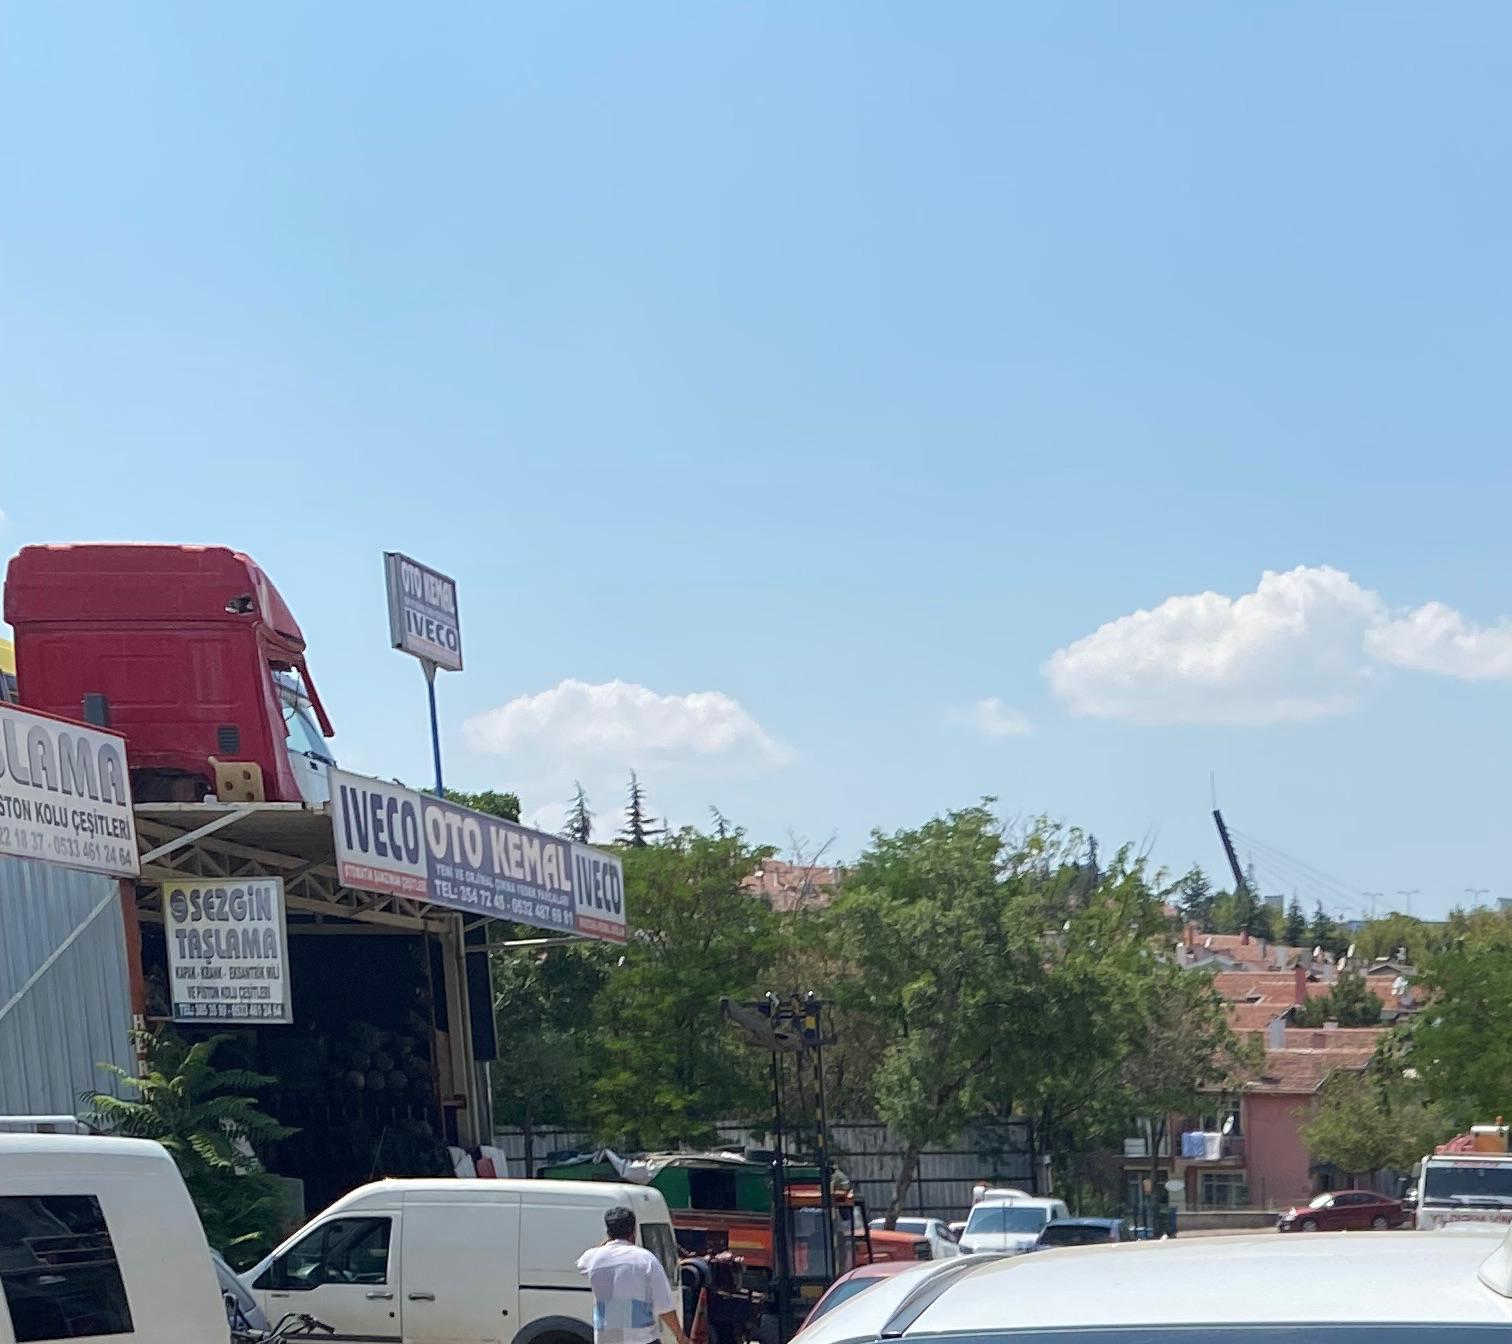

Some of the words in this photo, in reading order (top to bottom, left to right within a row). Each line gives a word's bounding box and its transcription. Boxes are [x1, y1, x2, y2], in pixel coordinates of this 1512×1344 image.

[401, 560, 422, 599] OTO
[405, 610, 458, 652] IVECO
[0, 718, 127, 808] LAMA
[34, 800, 69, 828] KOLU
[71, 808, 131, 840] ÇEŞİTLERİ
[340, 785, 420, 865] IVECO
[425, 806, 483, 869] OTO
[490, 825, 572, 892] KEMAL
[190, 885, 272, 922] SEZGİN
[434, 879, 458, 899] TEL:
[575, 854, 622, 915] IVECO
[175, 928, 277, 965] TAŞLAMA
